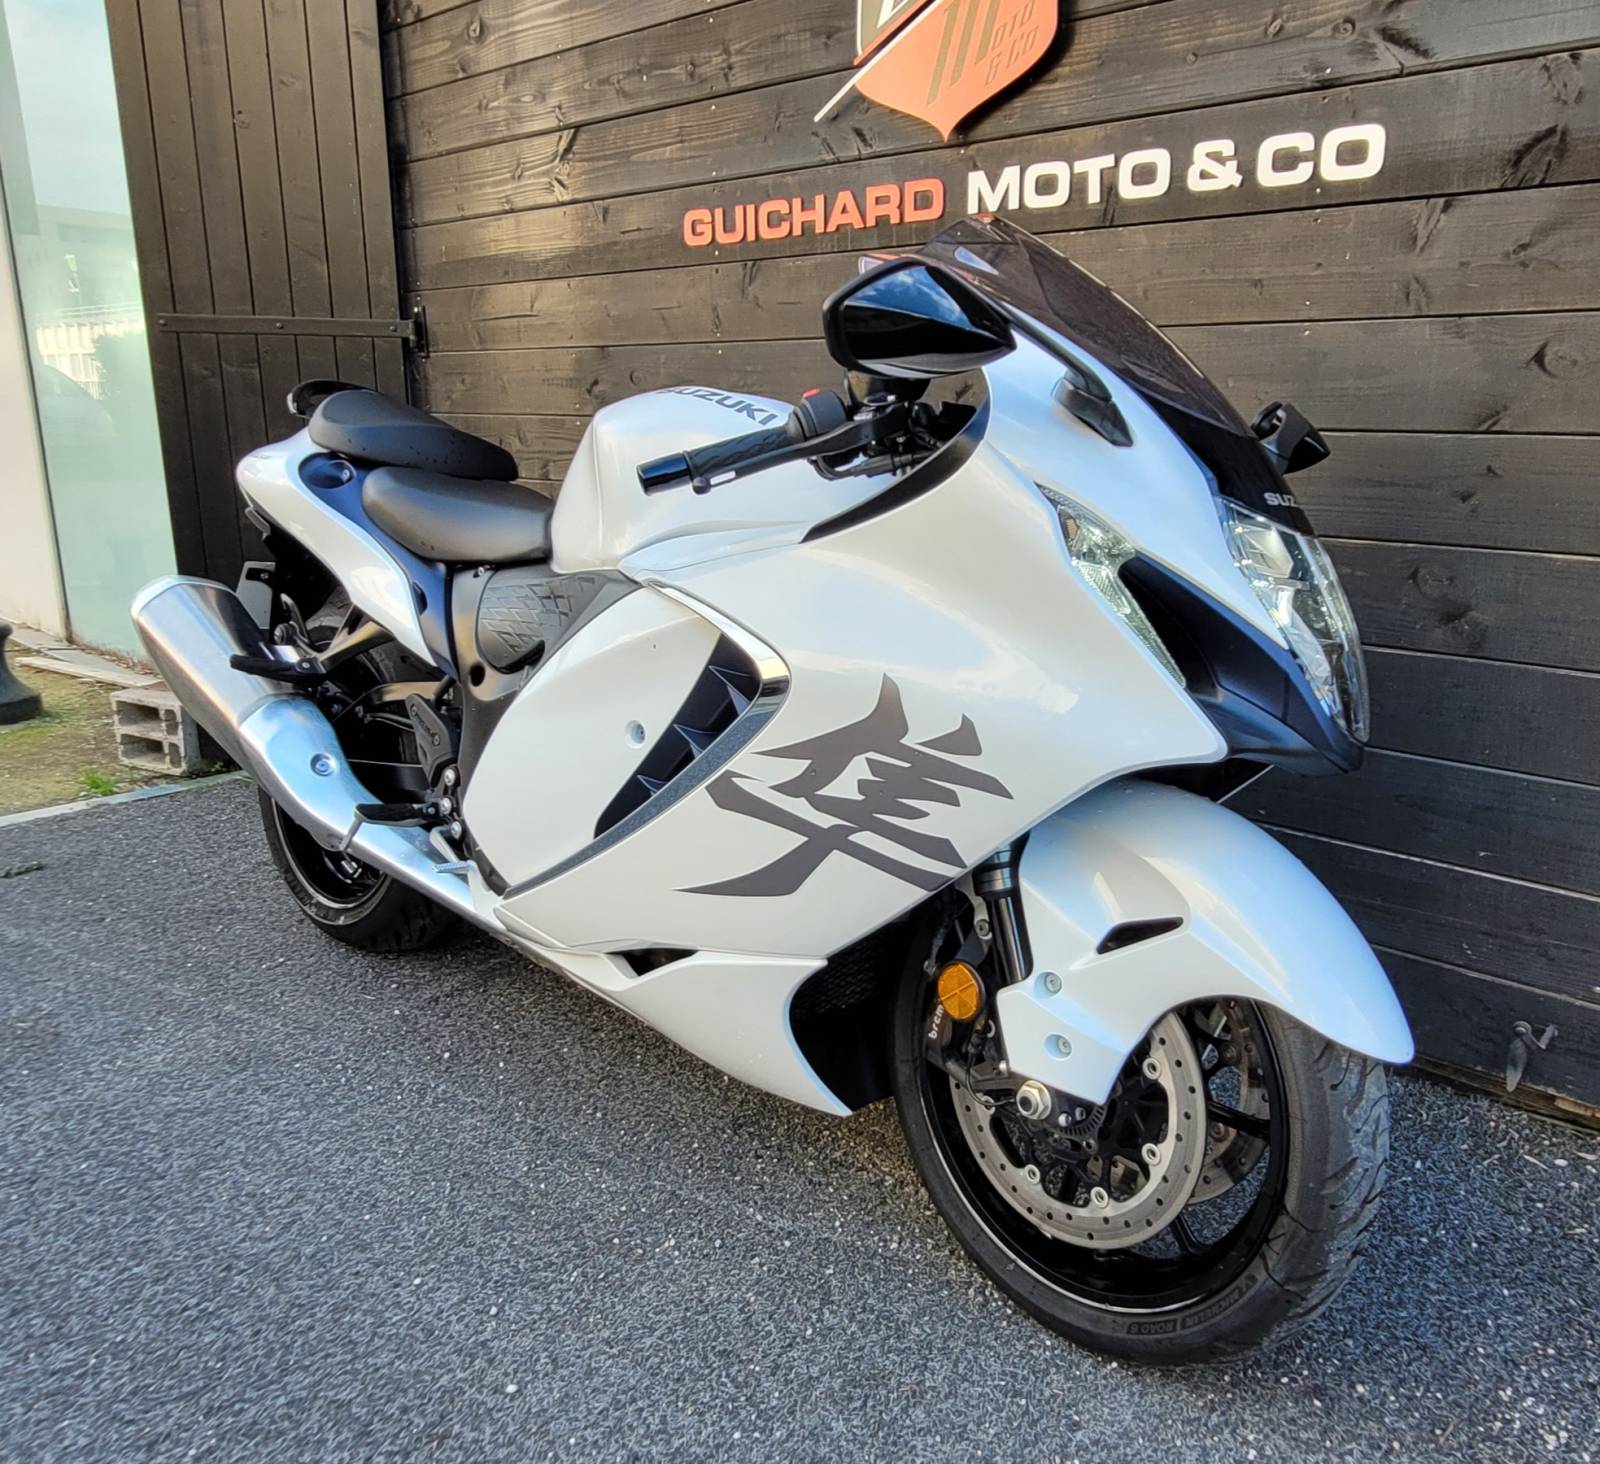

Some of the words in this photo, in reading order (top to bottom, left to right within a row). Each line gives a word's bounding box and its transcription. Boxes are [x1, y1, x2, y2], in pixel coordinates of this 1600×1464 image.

[684, 177, 944, 247] GUICHARD
[966, 148, 1171, 215] MOTO
[1187, 138, 1243, 192] &
[1257, 122, 1387, 188] CO
[1141, 1320, 1174, 1335] ROAD
